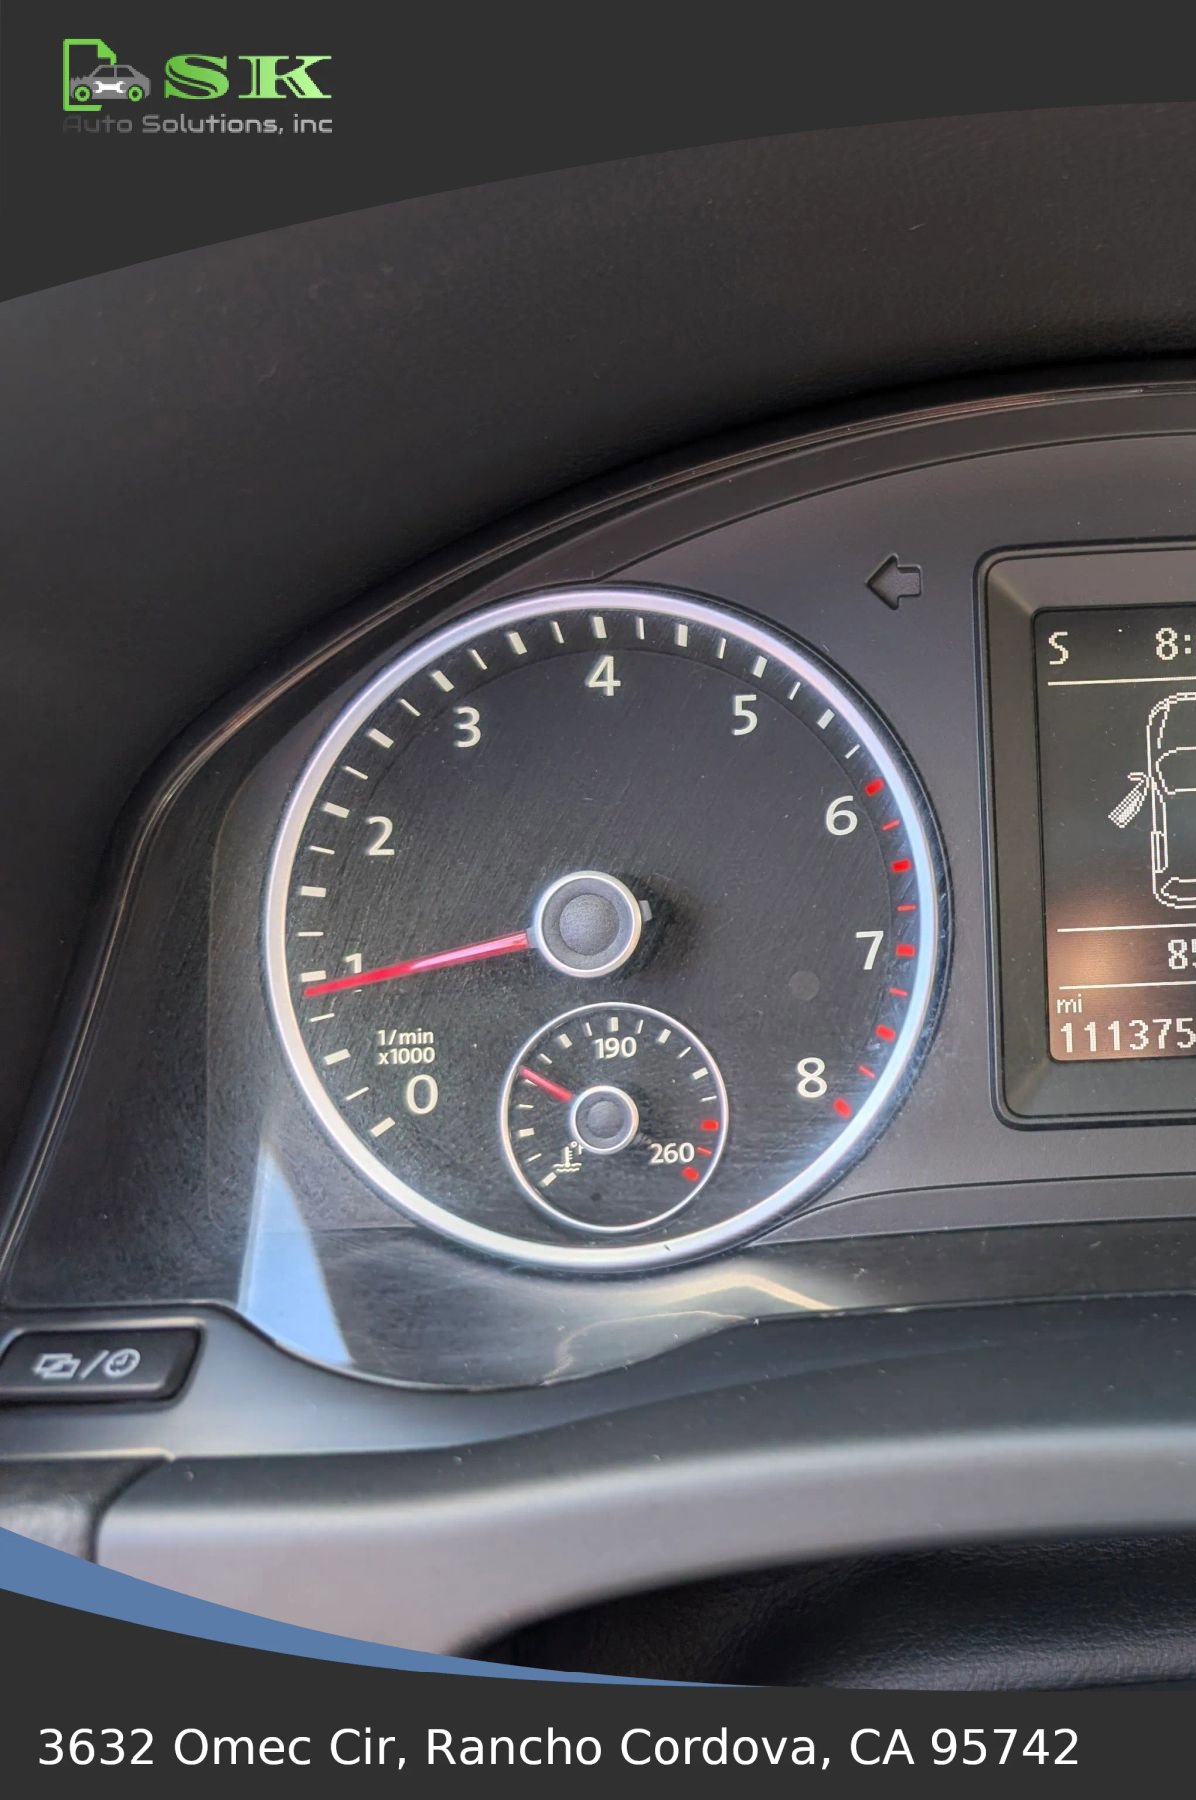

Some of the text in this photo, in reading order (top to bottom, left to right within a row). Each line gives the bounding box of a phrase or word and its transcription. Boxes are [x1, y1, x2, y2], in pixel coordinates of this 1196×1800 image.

[1049, 632, 1068, 665] S
[586, 656, 621, 696] 4
[454, 707, 481, 747] 3
[733, 695, 757, 734] 5
[826, 796, 857, 835] 6
[367, 817, 395, 856] 2
[856, 931, 883, 969] 7
[345, 953, 363, 993] 1
[1057, 995, 1083, 1014] mi
[377, 1028, 434, 1046] 1/min
[594, 1037, 637, 1059] 190
[1060, 1018, 1196, 1053] 111375
[378, 1046, 435, 1065] x1000
[406, 1074, 438, 1114] 0
[797, 1057, 827, 1098] 8
[650, 1142, 695, 1164] 260
